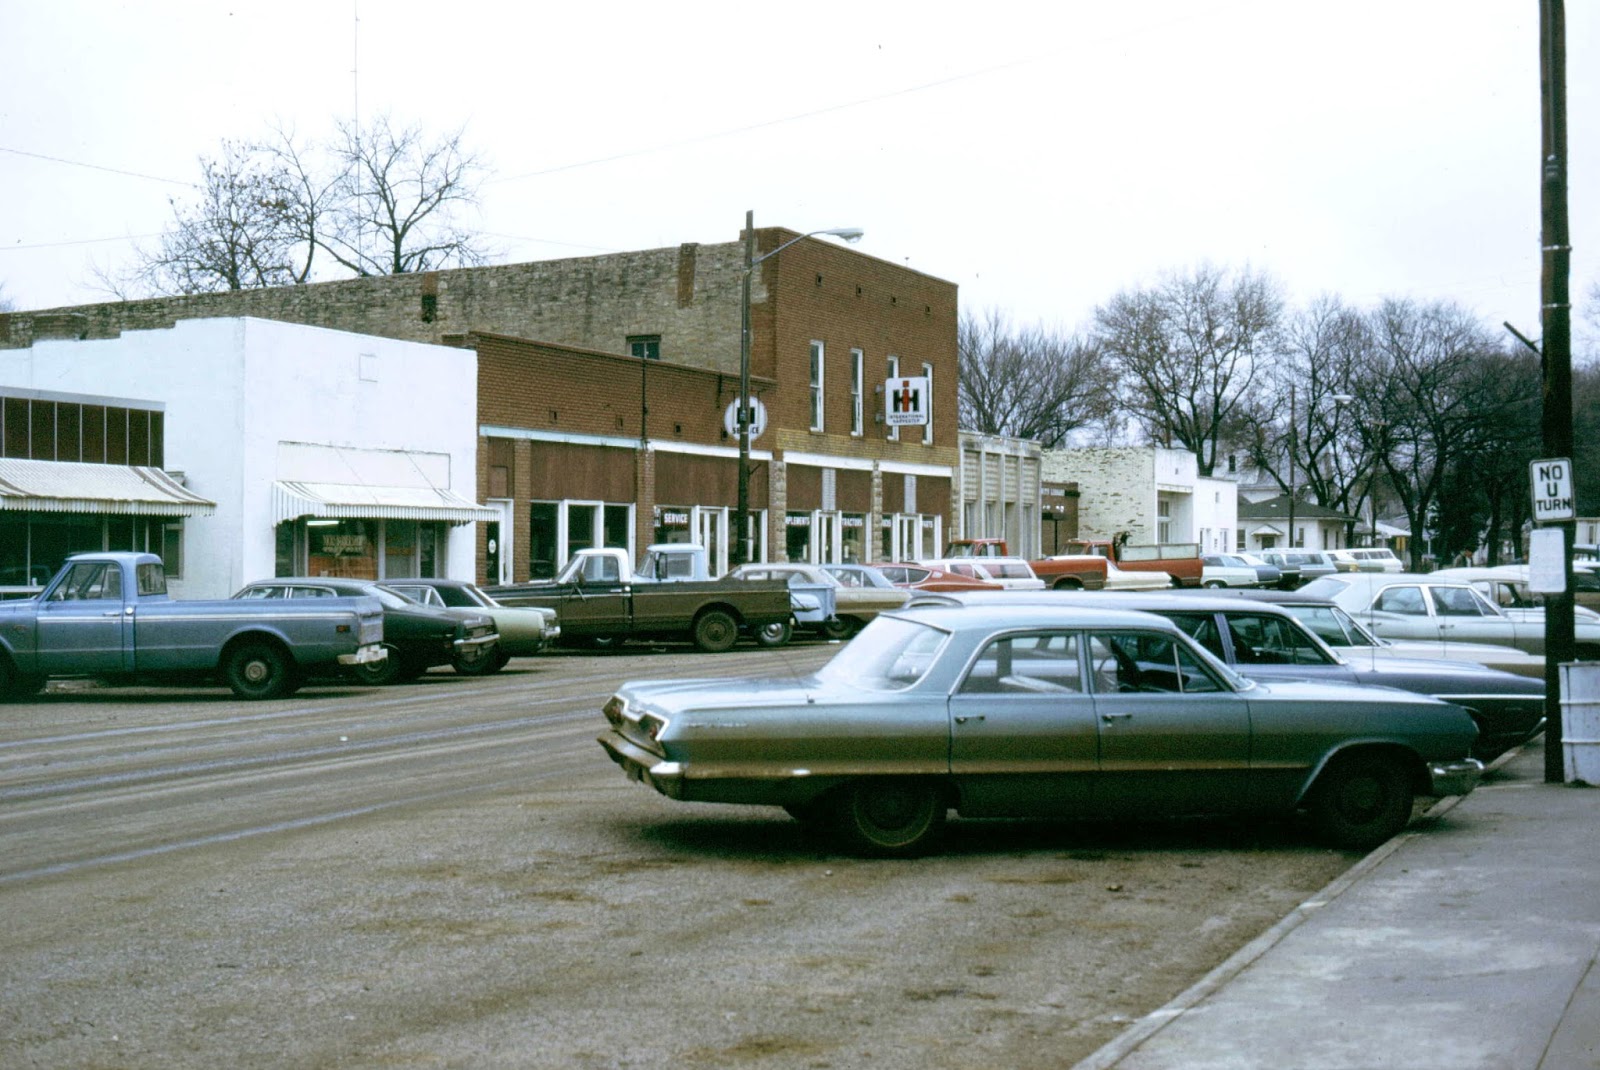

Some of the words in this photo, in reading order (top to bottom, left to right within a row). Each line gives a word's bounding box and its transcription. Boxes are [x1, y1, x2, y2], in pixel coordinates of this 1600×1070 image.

[1539, 465, 1563, 482] NO
[1547, 482, 1558, 497] U
[1536, 498, 1572, 512] TURN
[664, 513, 688, 524] SERVICE
